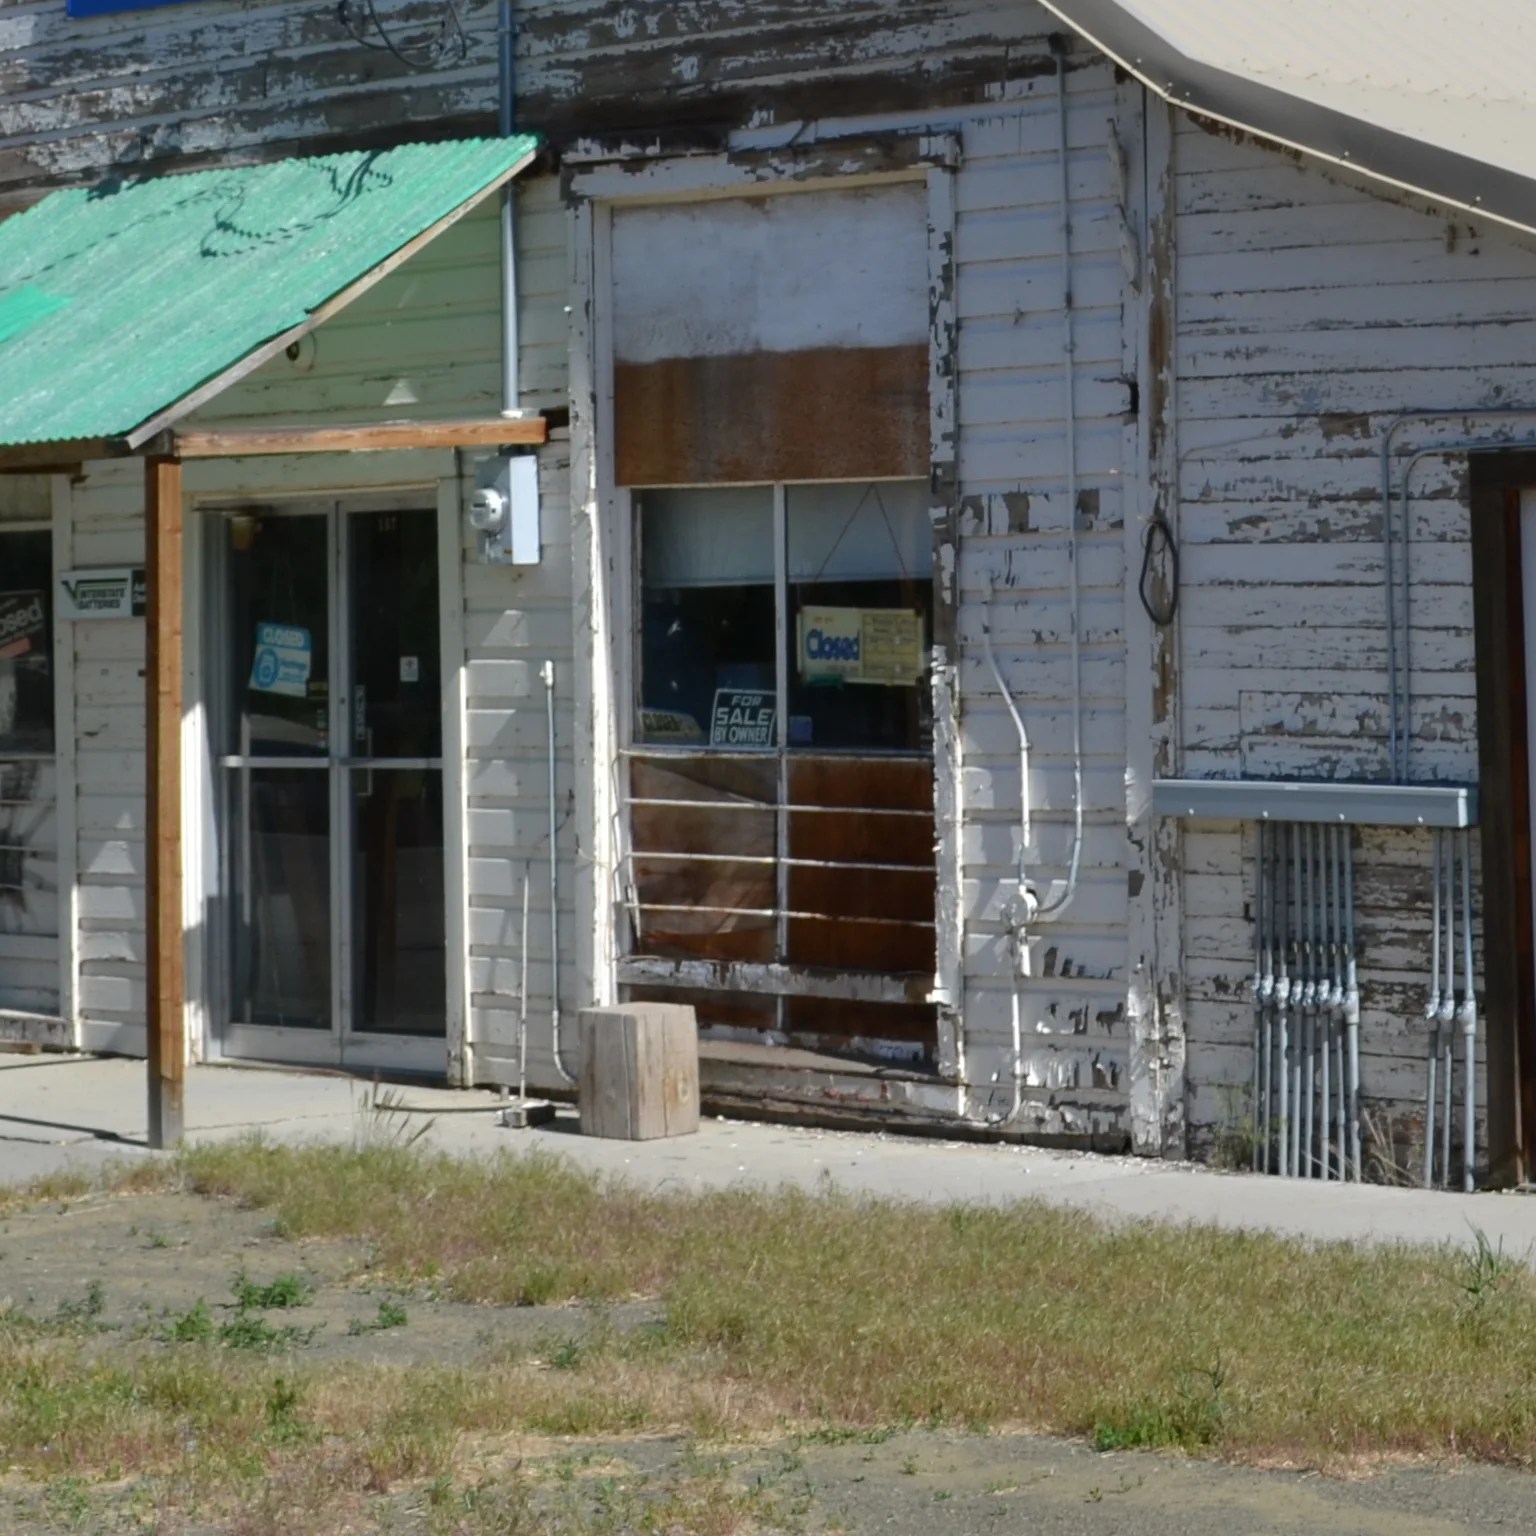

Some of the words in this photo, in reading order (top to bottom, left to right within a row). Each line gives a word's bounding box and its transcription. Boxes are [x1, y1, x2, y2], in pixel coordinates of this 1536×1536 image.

[806, 628, 861, 661] Closed
[731, 695, 763, 707] FOR
[715, 707, 773, 726] SALE
[714, 727, 727, 743] BY
[728, 726, 769, 743] OWNER
